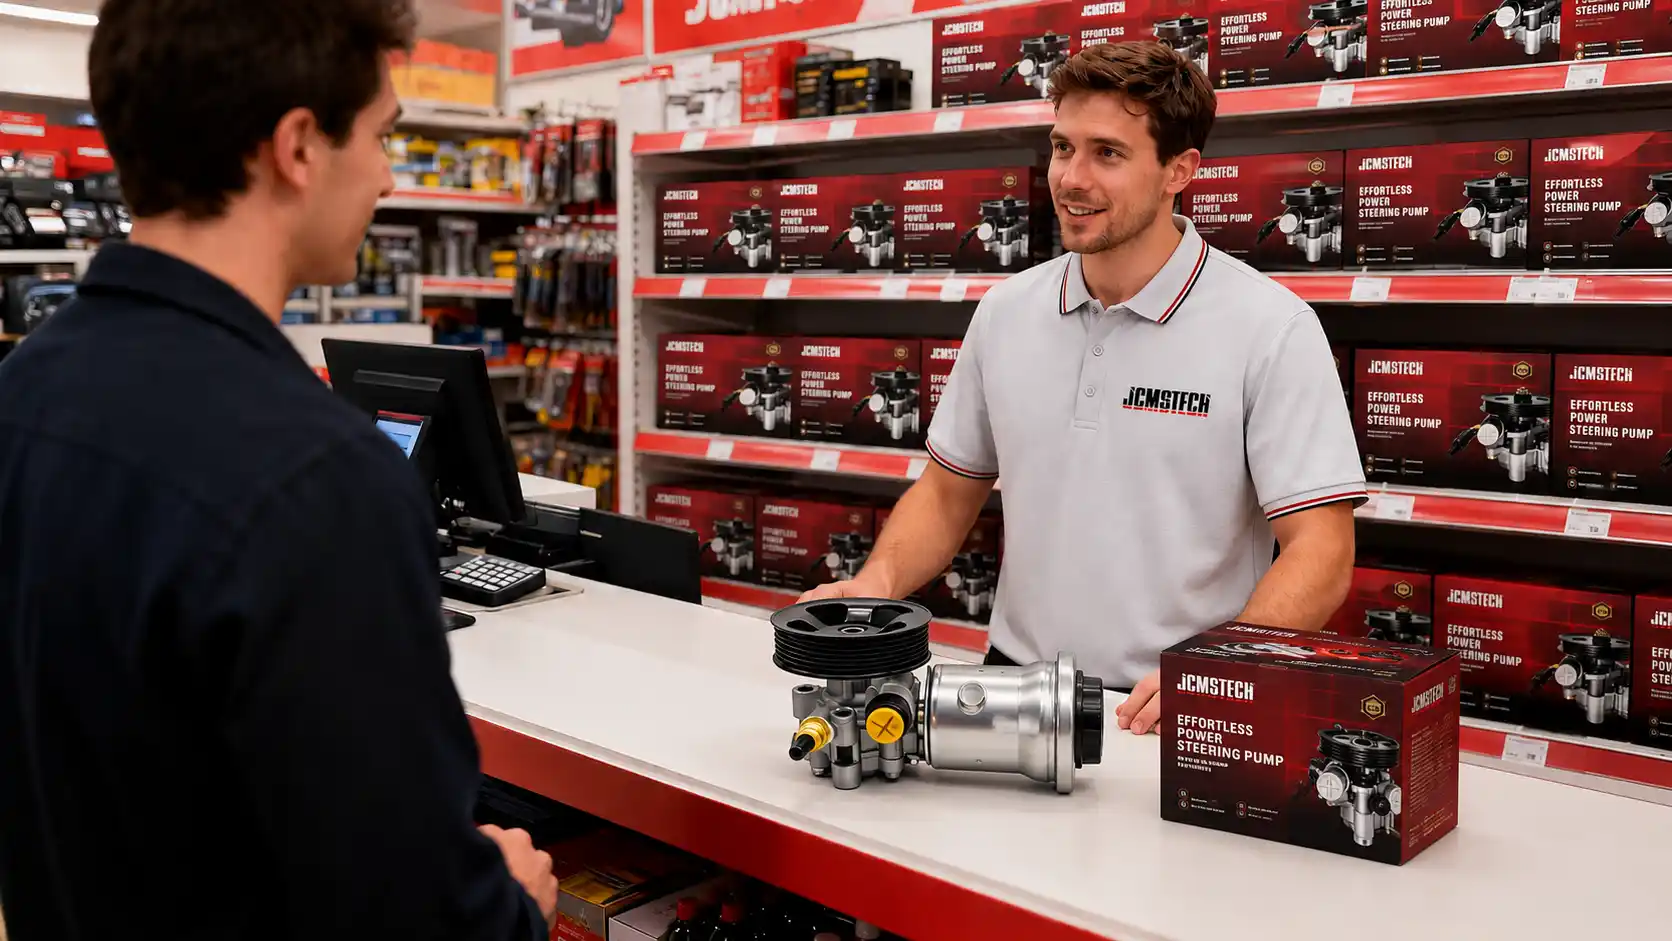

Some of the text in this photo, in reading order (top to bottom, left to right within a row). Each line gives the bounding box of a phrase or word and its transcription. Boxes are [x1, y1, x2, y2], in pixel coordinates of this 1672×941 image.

[1575, 0, 1651, 15] STEERING PUMP
[1221, 12, 1267, 26] EFFORTLESS
[1381, 9, 1412, 21] POWER
[1381, 16, 1450, 32] STEERING PUMP
[1258, 31, 1282, 42] PUMP
[1544, 145, 1604, 162] JCMSTECH
[1358, 155, 1412, 171] JCMSTECH
[1359, 185, 1412, 196] EFFORTLESS
[1544, 178, 1603, 190] EFFORTLESS
[1192, 193, 1238, 203] EFFORTLESS
[1358, 196, 1390, 207] POWER
[1544, 190, 1579, 202] POWER
[903, 204, 943, 213] EFFORTLESS
[1358, 206, 1429, 218] STEERING PUMP
[1544, 201, 1621, 213] STEERING PUMP
[1229, 213, 1253, 223] PUMP
[935, 222, 955, 231] PUMP
[1367, 360, 1423, 375] JCMSTECH
[1569, 365, 1633, 382] JCMSTECH
[1367, 391, 1424, 404] EFFORTLESS
[1367, 403, 1400, 415] POWER
[1570, 399, 1634, 412] EFFORTLESS
[1367, 415, 1442, 429] STEERING PUMP
[1570, 412, 1608, 424] POWER
[1569, 425, 1653, 440] STEERING PUMP
[1447, 589, 1503, 608] JCMSTECH
[1447, 624, 1503, 641] EFFORTLESS
[1447, 635, 1481, 649] POWER
[1493, 653, 1522, 666] PUMP
[1177, 673, 1255, 701] JCMSTECH
[1177, 713, 1253, 736] EFFORTLESS
[1177, 727, 1223, 745] POWER
[1177, 740, 1241, 761] STEERING
[1244, 750, 1284, 767] PUMP
